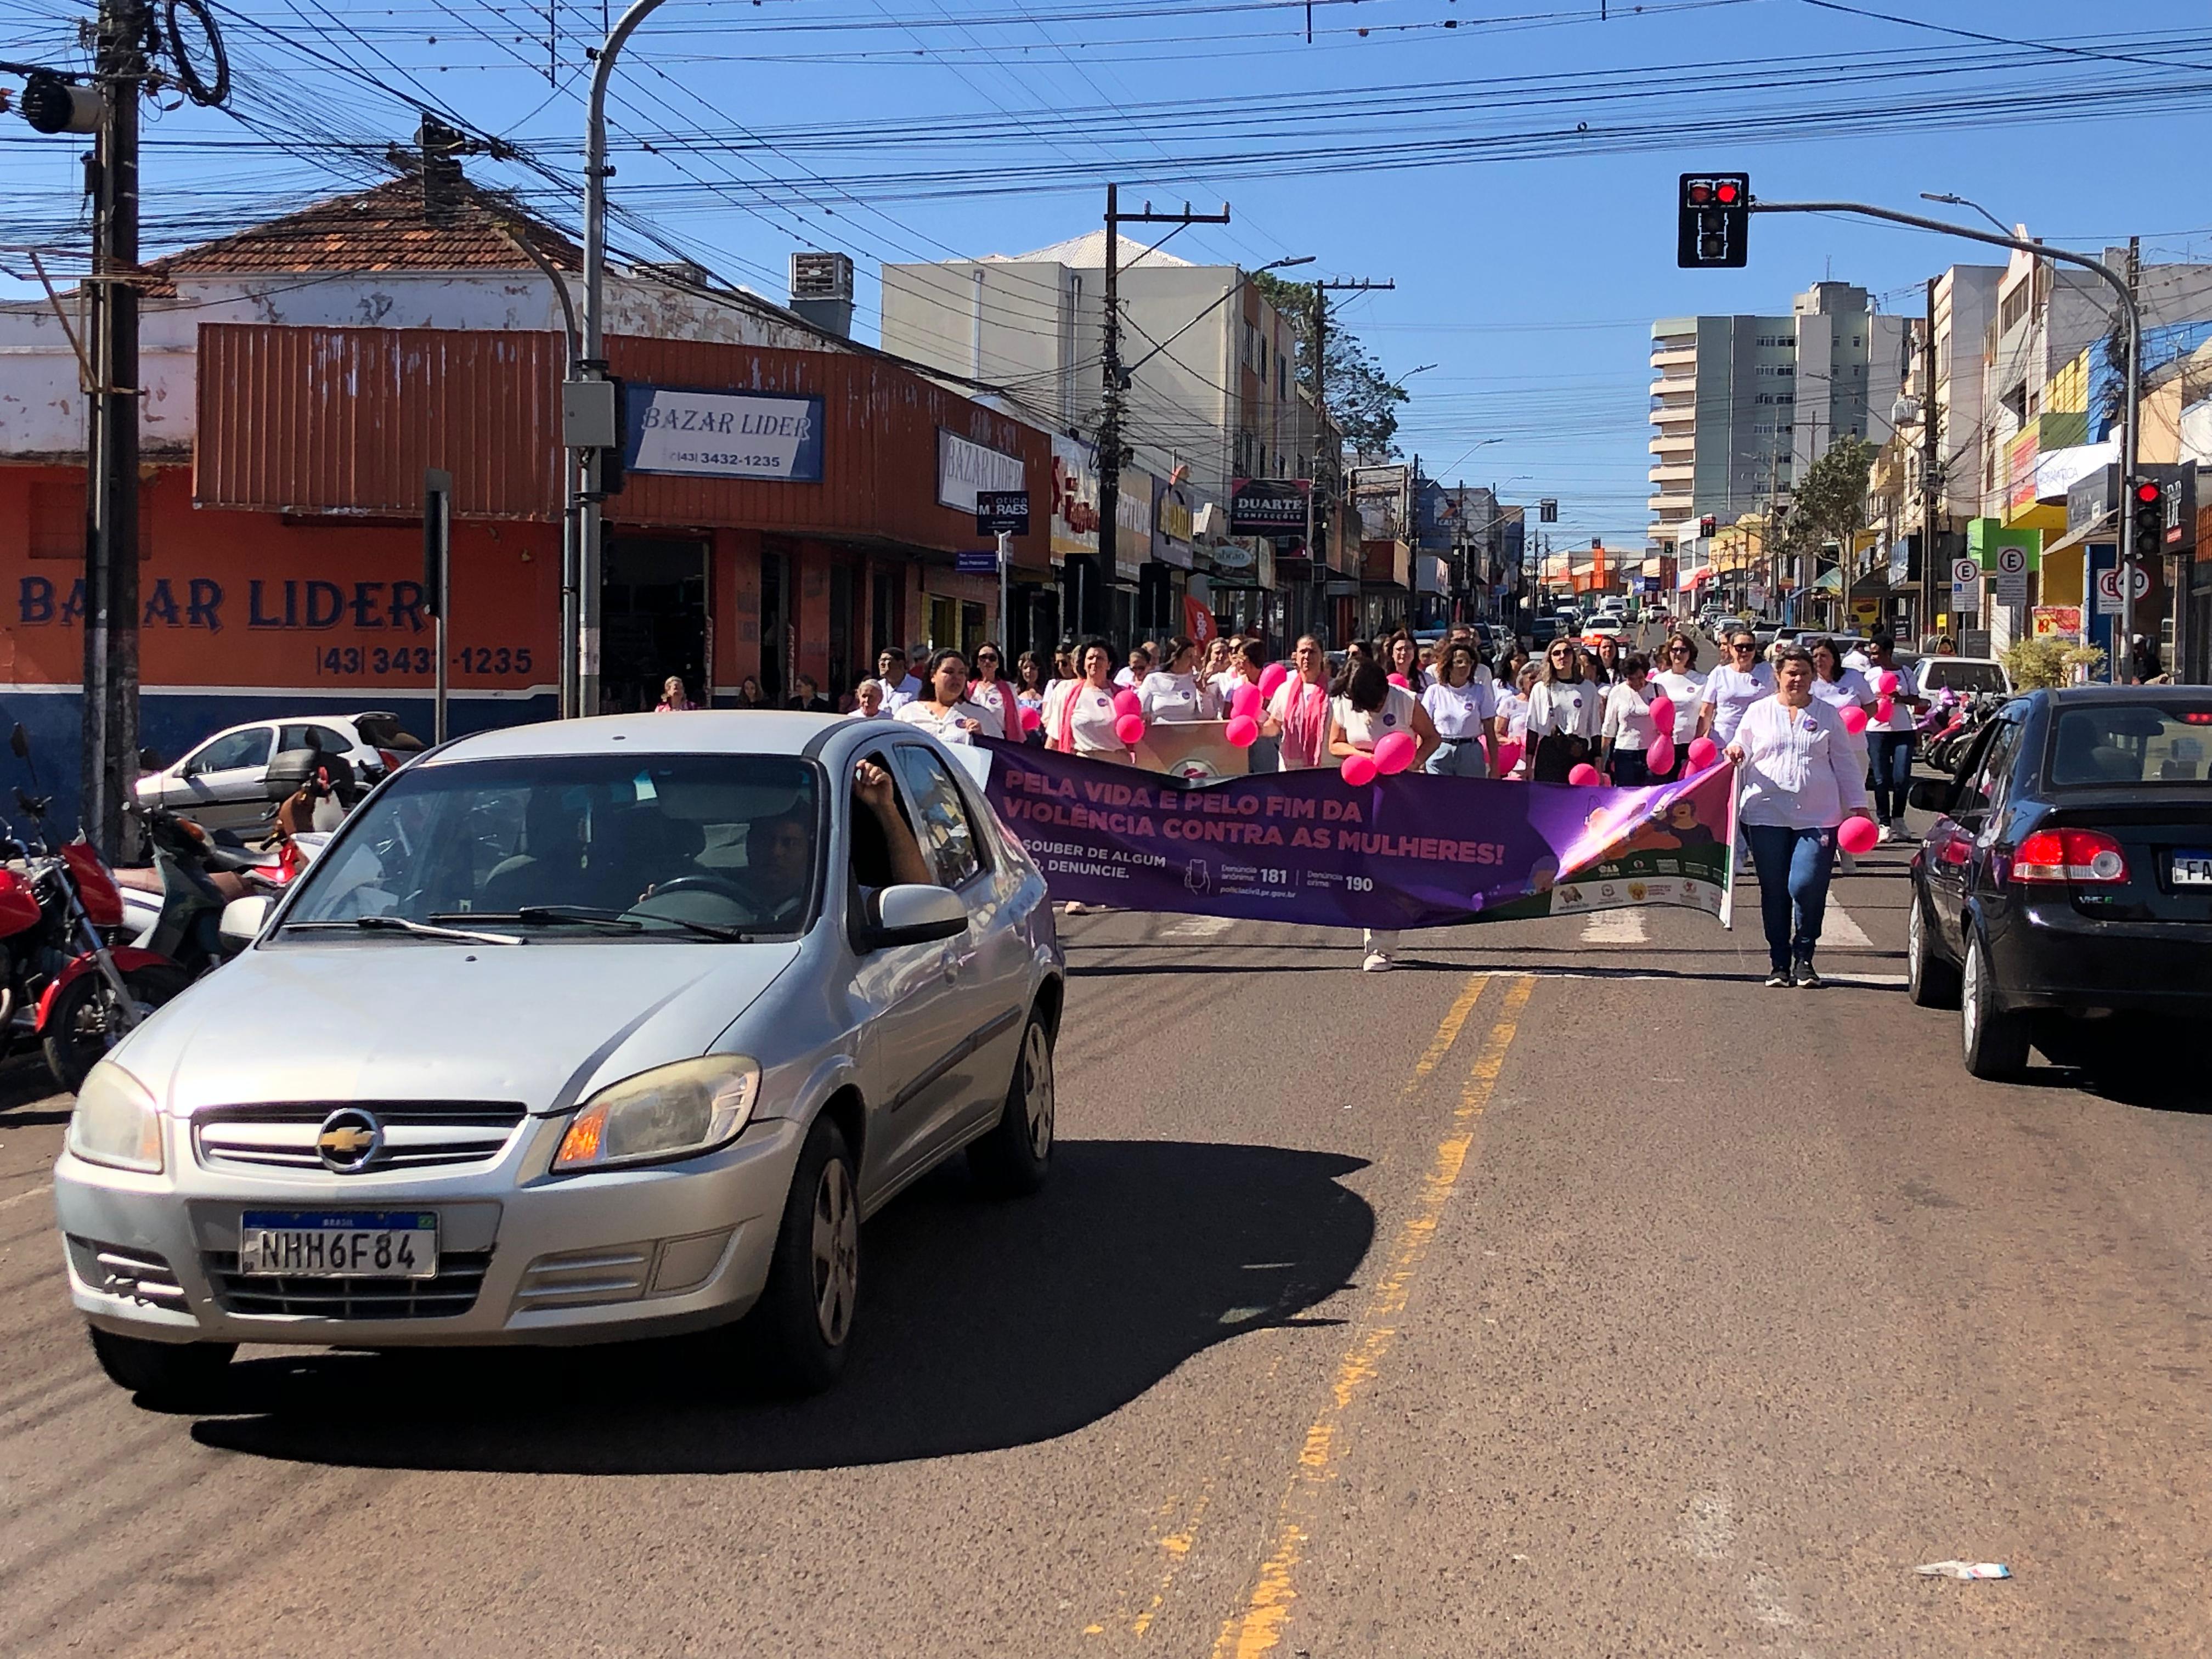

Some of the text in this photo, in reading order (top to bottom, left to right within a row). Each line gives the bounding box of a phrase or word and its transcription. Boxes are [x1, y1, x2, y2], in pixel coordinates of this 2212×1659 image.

[644, 407, 811, 439] BAZAR LIDER
[701, 453, 780, 467] 3432-1235
[947, 440, 1022, 492] BAZAR LIDER
[1238, 498, 1302, 510] DUARTE
[1962, 565, 1970, 577] E
[2007, 554, 2017, 568] E
[19, 577, 430, 635] BAAR LIDER
[373, 647, 532, 674] 343-1235
[1006, 770, 1363, 823] PELA VIDA E PELO FIM DA
[1002, 795, 1505, 865] VIOLÊNCIA CONTRA AS MULHERES!
[1023, 839, 1166, 867] SOUBER DE ALGUM
[1048, 859, 1130, 878] DENUNCIE.
[1260, 868, 1287, 884] 181
[1346, 876, 1373, 891] 190
[322, 1218, 354, 1227] BRASIL
[261, 1232, 415, 1269] NHH6F84
